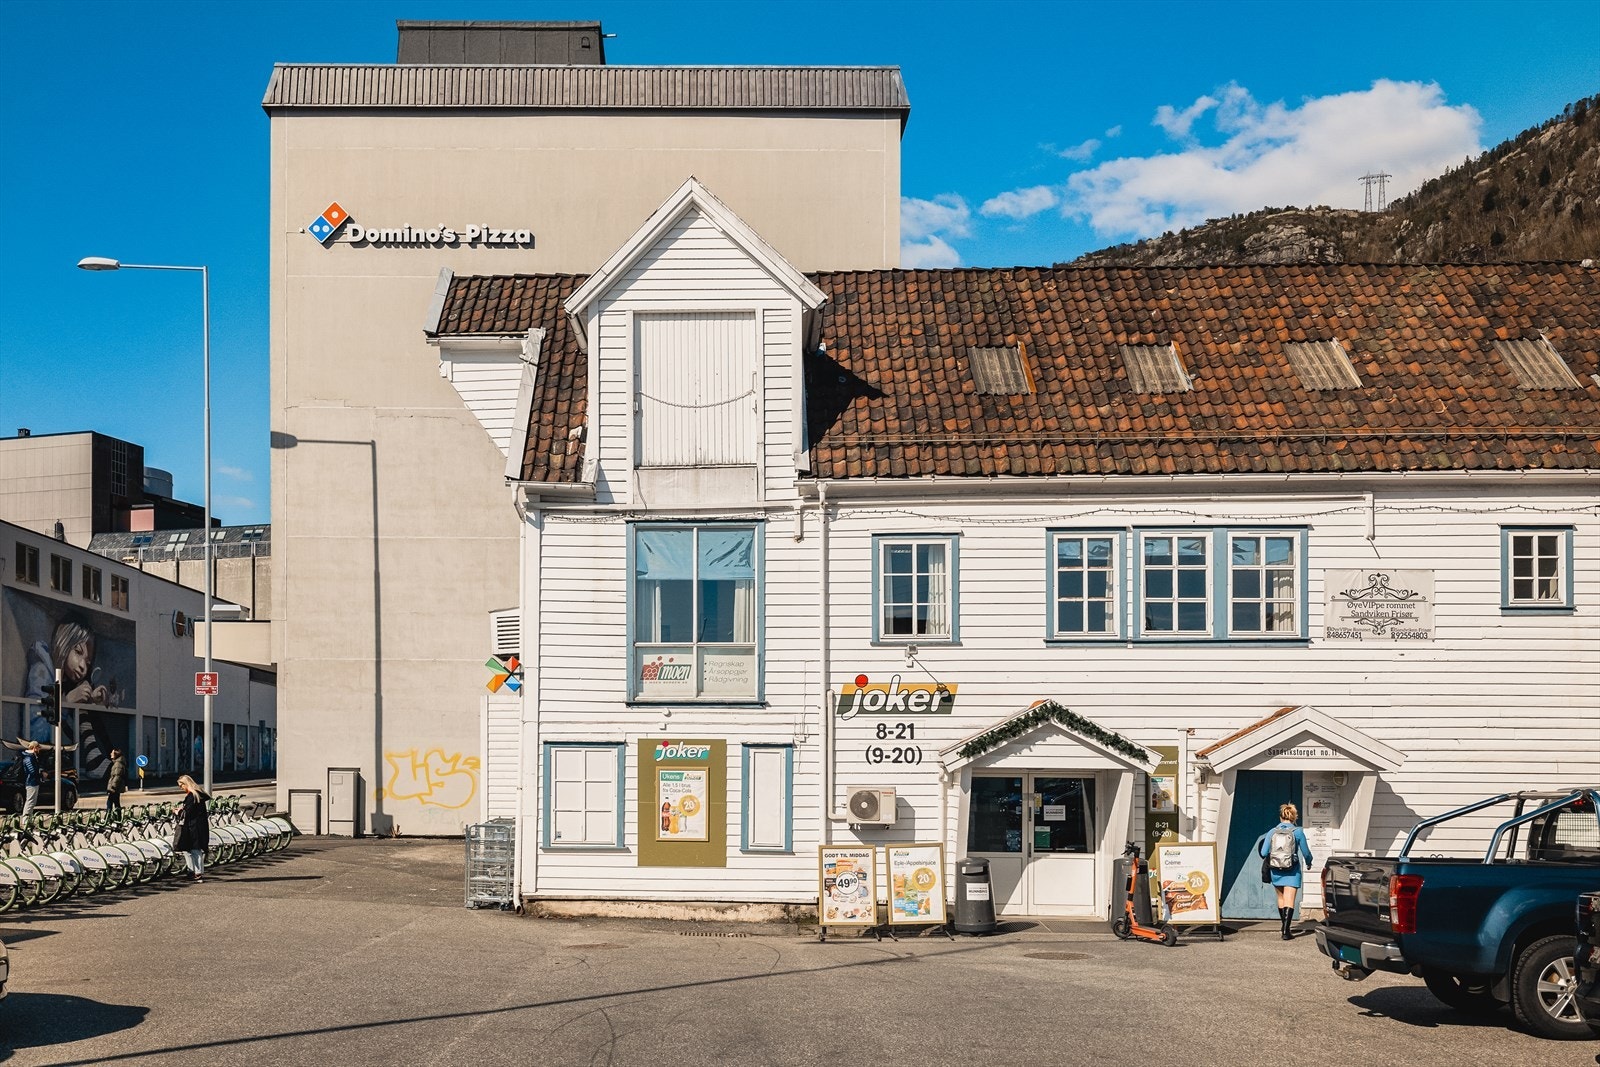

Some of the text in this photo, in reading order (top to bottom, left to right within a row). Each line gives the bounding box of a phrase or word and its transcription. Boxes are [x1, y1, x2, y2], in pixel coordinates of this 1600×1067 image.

[347, 222, 531, 243] Domino's Pizza
[660, 665, 691, 680] moen
[709, 676, 749, 684] Rådgivning
[842, 674, 949, 721] joker
[876, 723, 915, 740] 8-21
[655, 741, 708, 762] joker
[865, 745, 923, 766] (9-20)
[1268, 748, 1316, 757] Sandvikstorget
[683, 800, 696, 811] 20
[1155, 821, 1169, 829] 8-21
[1152, 830, 1173, 838] (9-20)
[917, 873, 930, 884] 20
[1190, 877, 1203, 888] 20
